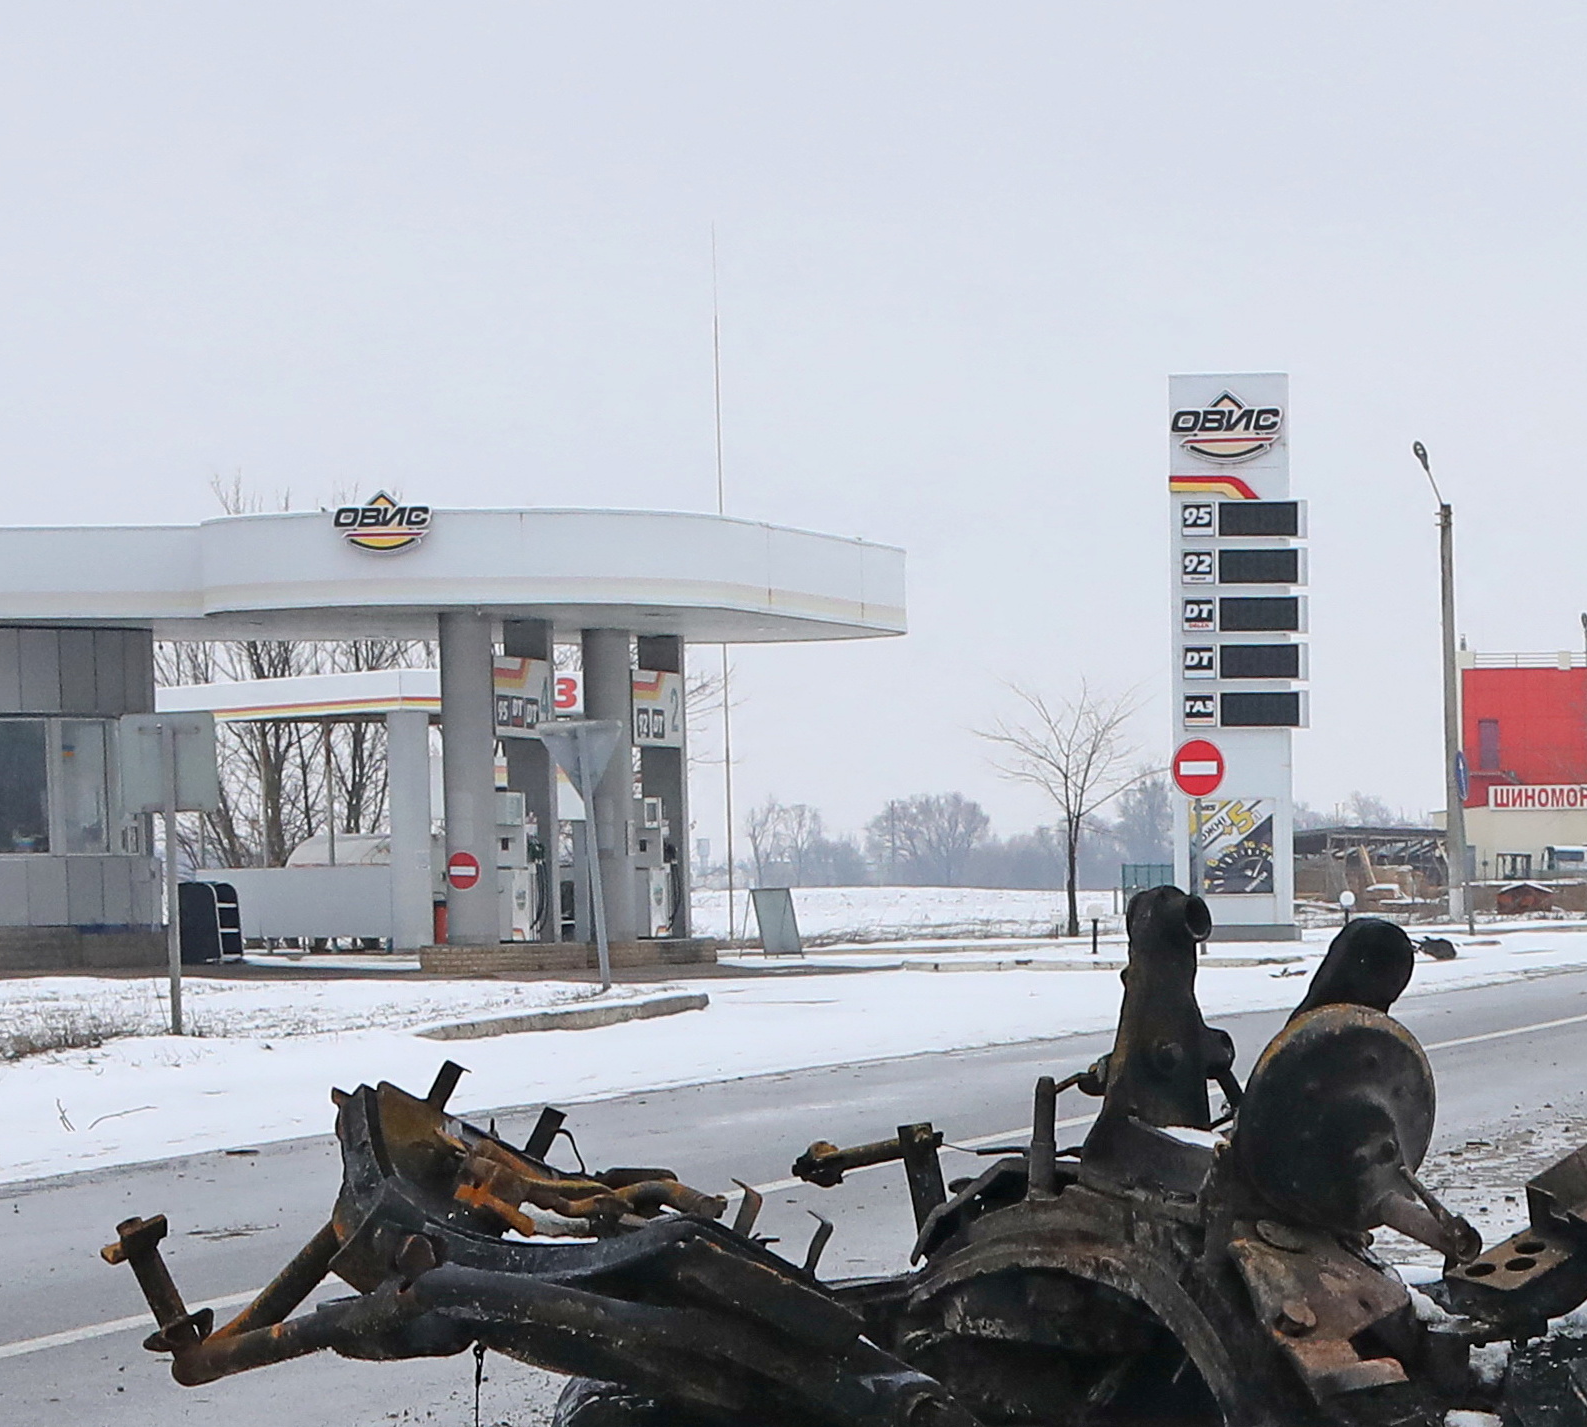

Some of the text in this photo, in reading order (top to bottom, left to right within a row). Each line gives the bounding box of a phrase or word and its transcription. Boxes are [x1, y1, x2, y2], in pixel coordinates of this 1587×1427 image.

[1171, 408, 1280, 432] ОВИС
[334, 506, 430, 527] ОВИС
[1183, 507, 1212, 525] 95
[1183, 555, 1212, 572] 92
[1184, 604, 1213, 618] DT
[1184, 651, 1213, 666] DT
[554, 677, 577, 708] 3
[498, 700, 508, 721] 95
[670, 688, 679, 732] 2
[1185, 701, 1214, 712] ГАЗ
[638, 713, 648, 733] 92
